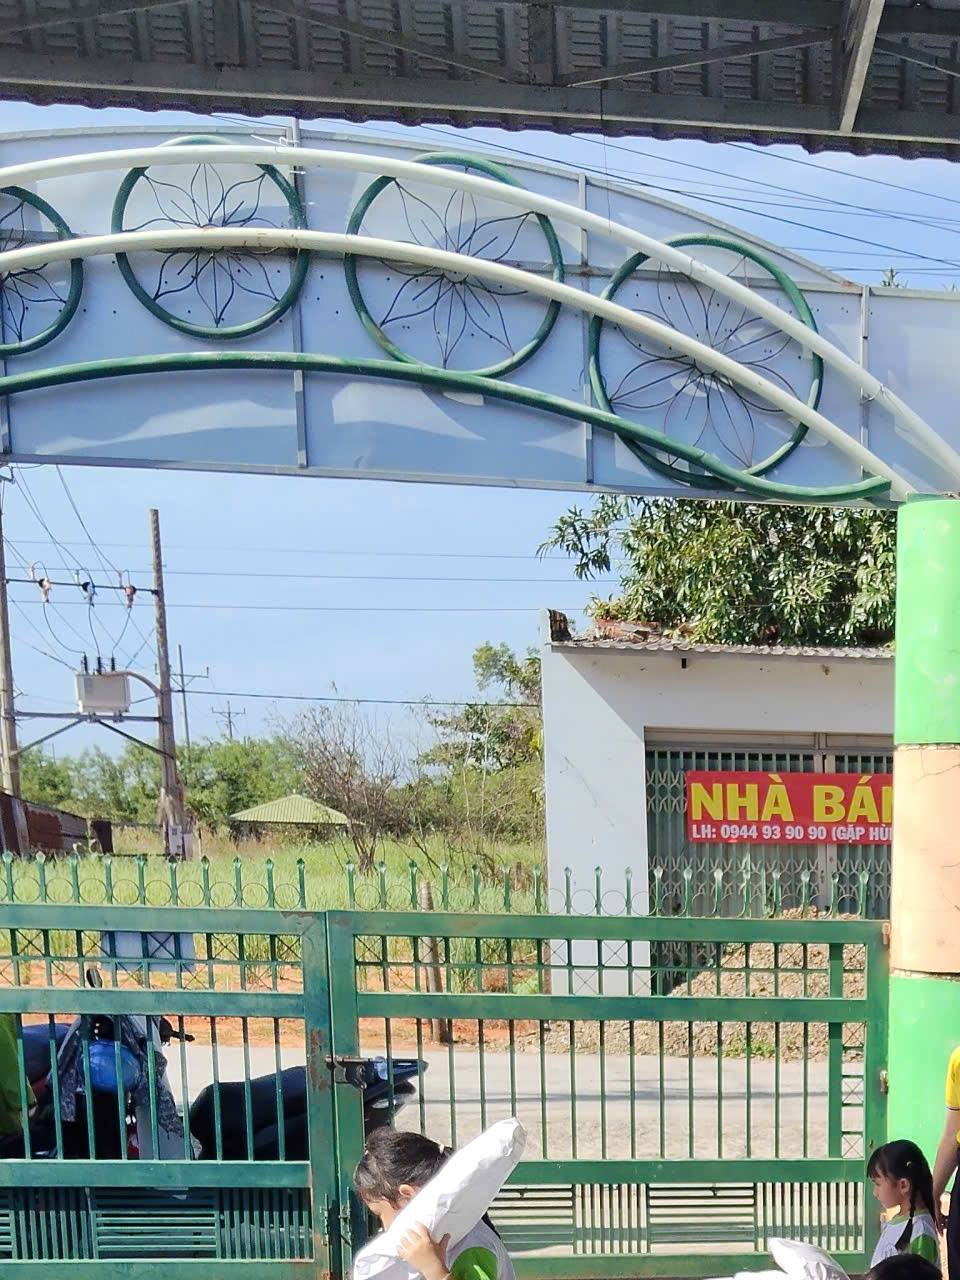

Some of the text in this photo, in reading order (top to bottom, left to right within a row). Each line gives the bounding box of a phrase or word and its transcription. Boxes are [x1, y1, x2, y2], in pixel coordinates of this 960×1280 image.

[691, 774, 794, 822] NHÀ
[692, 825, 716, 839] LH:
[720, 825, 758, 839] 0944
[762, 826, 781, 839] 93
[785, 826, 803, 840] 90
[808, 826, 827, 840] 90
